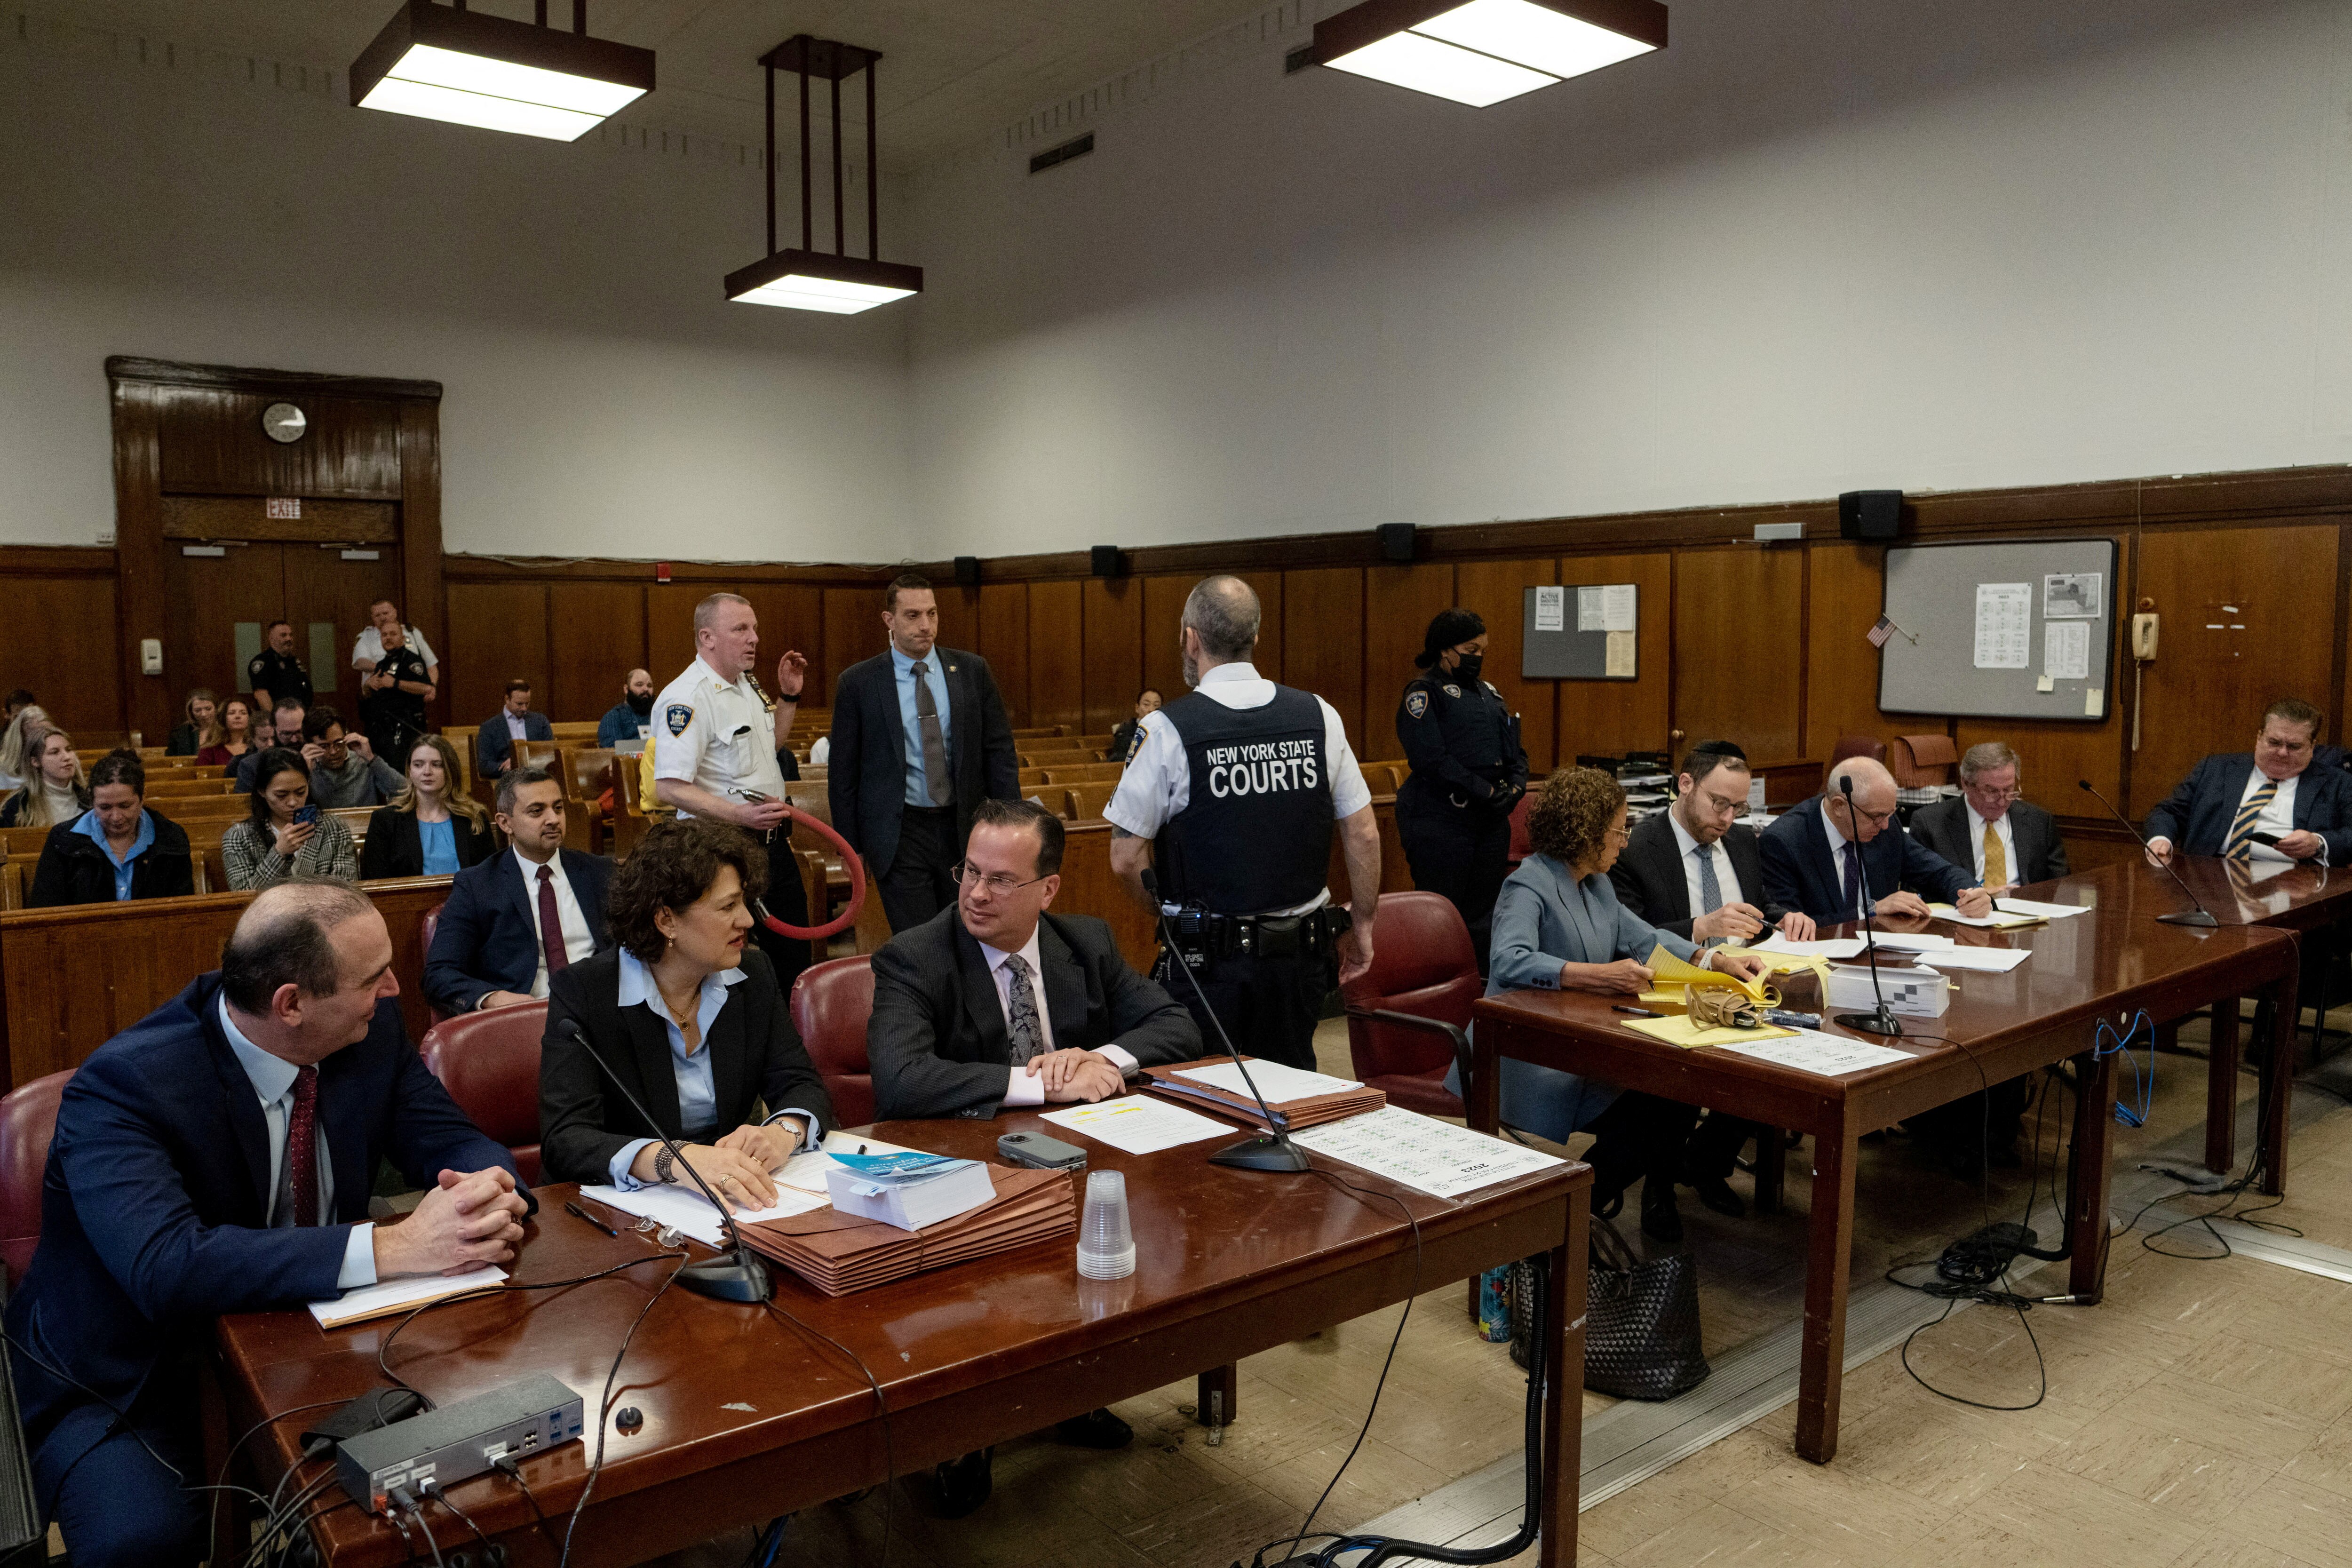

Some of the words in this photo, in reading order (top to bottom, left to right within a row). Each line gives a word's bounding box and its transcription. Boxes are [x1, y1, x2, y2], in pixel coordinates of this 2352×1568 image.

[269, 498, 297, 517] EXIT
[1207, 747, 1238, 766] NEW
[1240, 743, 1278, 762] YORK
[1279, 740, 1316, 758] STATE
[1209, 757, 1318, 798] COURTS
[1461, 1163, 1489, 1173] 2023
[1493, 1161, 1519, 1170] UNIFIED
[1447, 1173, 1472, 1183] SYSTEM
